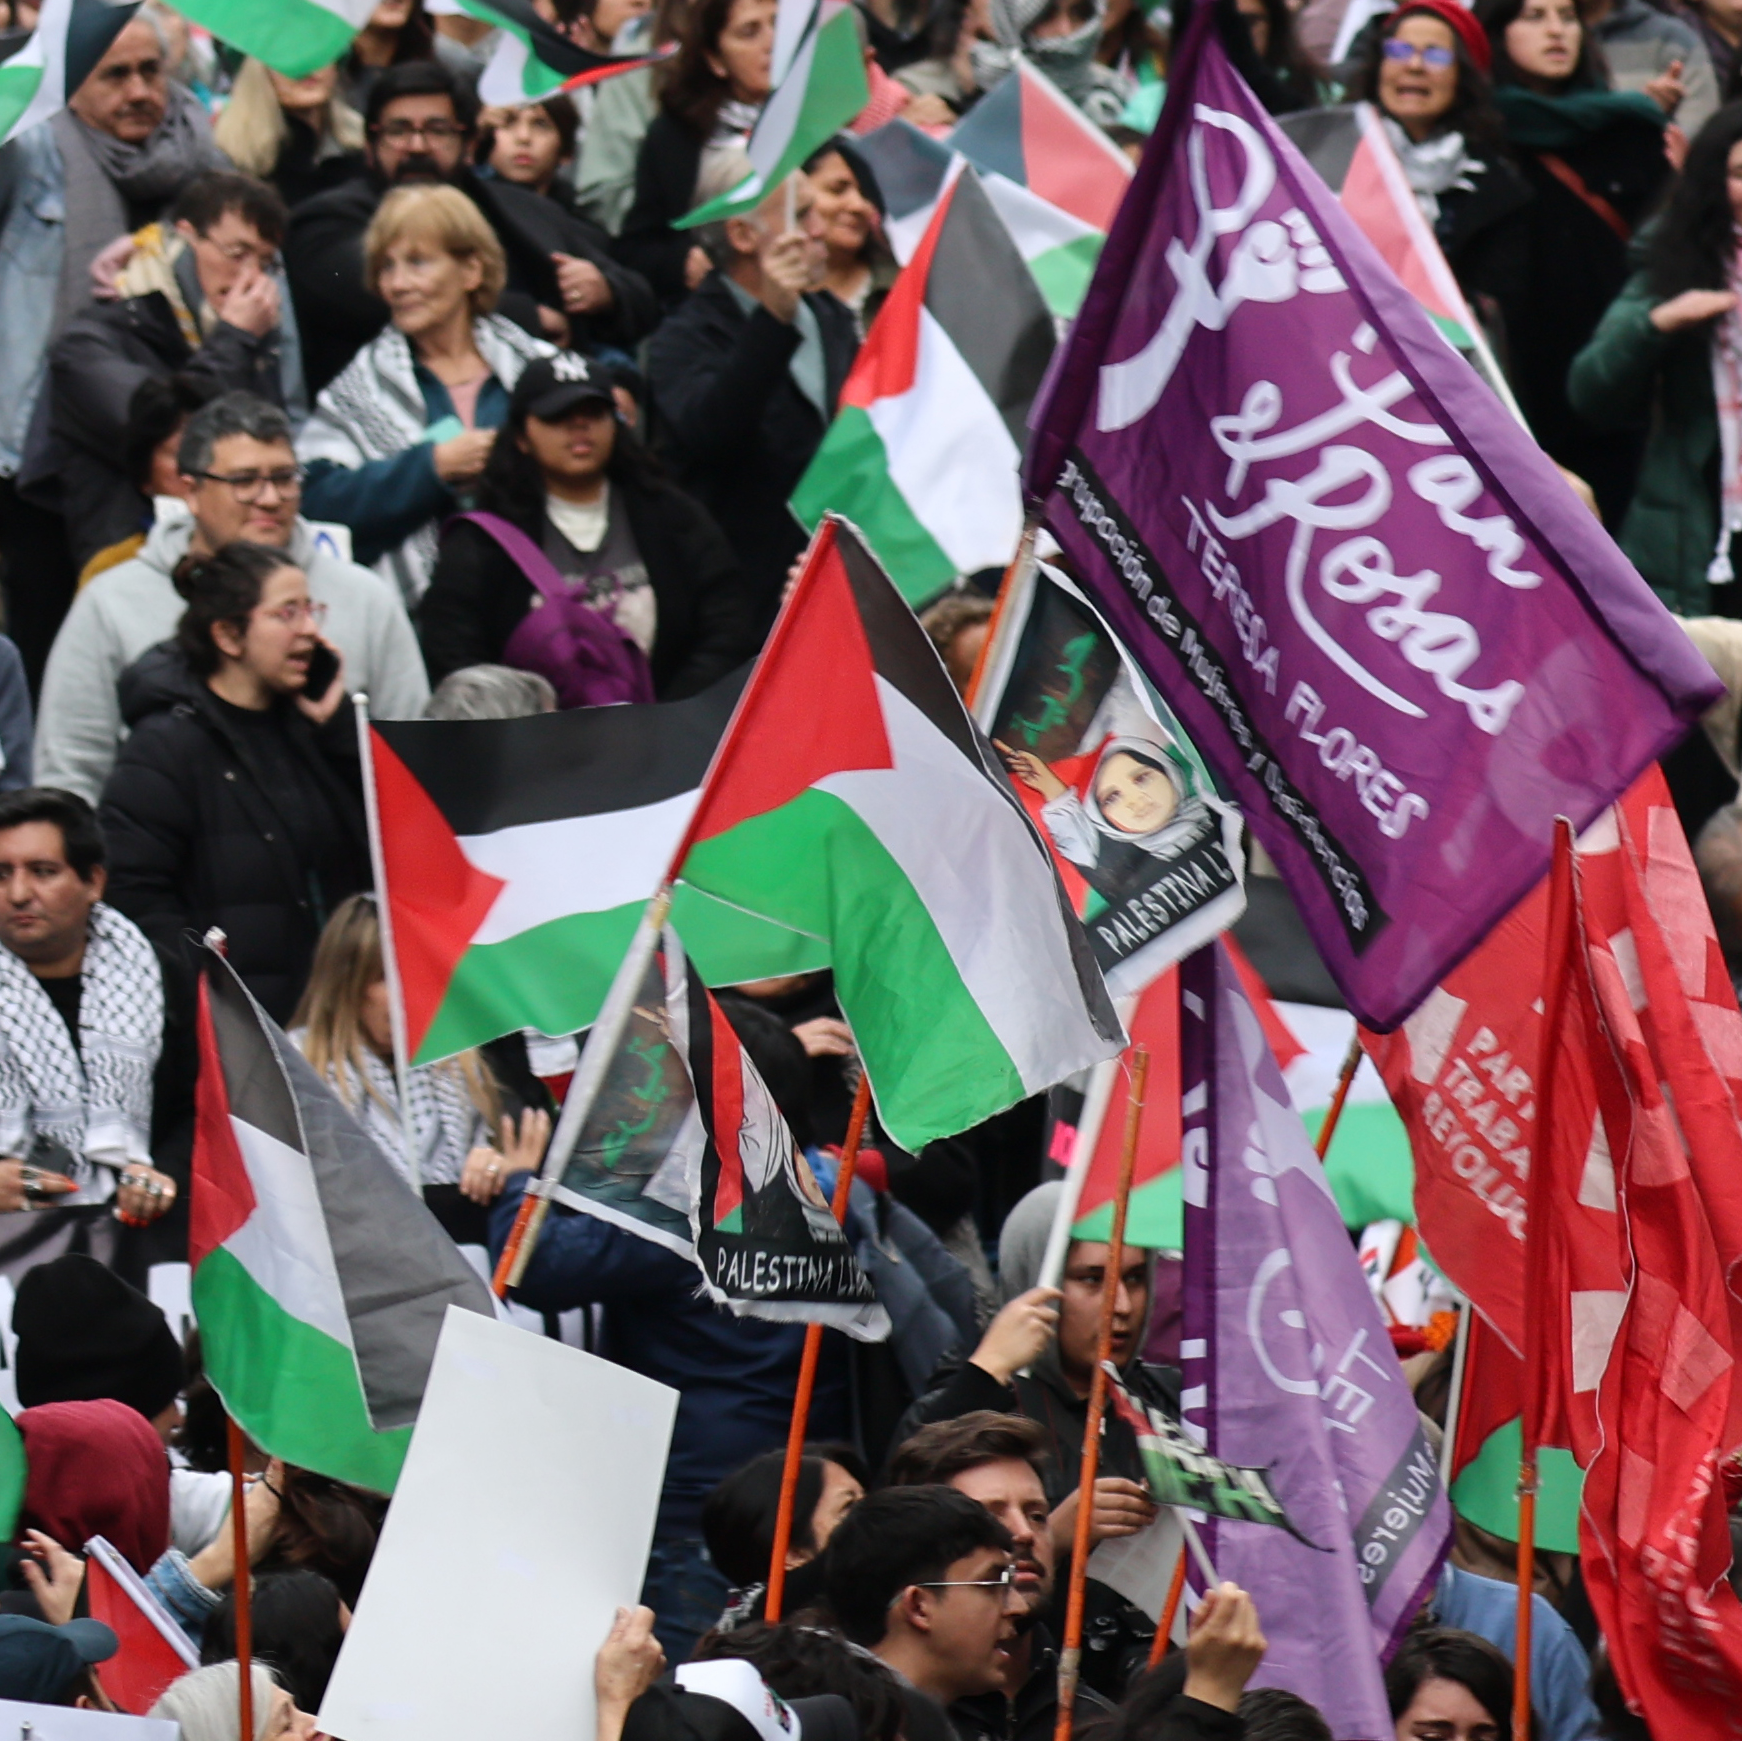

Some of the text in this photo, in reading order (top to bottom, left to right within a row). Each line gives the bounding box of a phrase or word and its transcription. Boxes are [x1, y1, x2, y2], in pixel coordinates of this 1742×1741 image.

[1146, 593, 1183, 639] de
[1205, 444, 1527, 736] Rosas
[1181, 494, 1430, 840] TERESA FLORES
[1096, 860, 1220, 958] PALESTINA
[716, 1246, 835, 1294] PALESTINA
